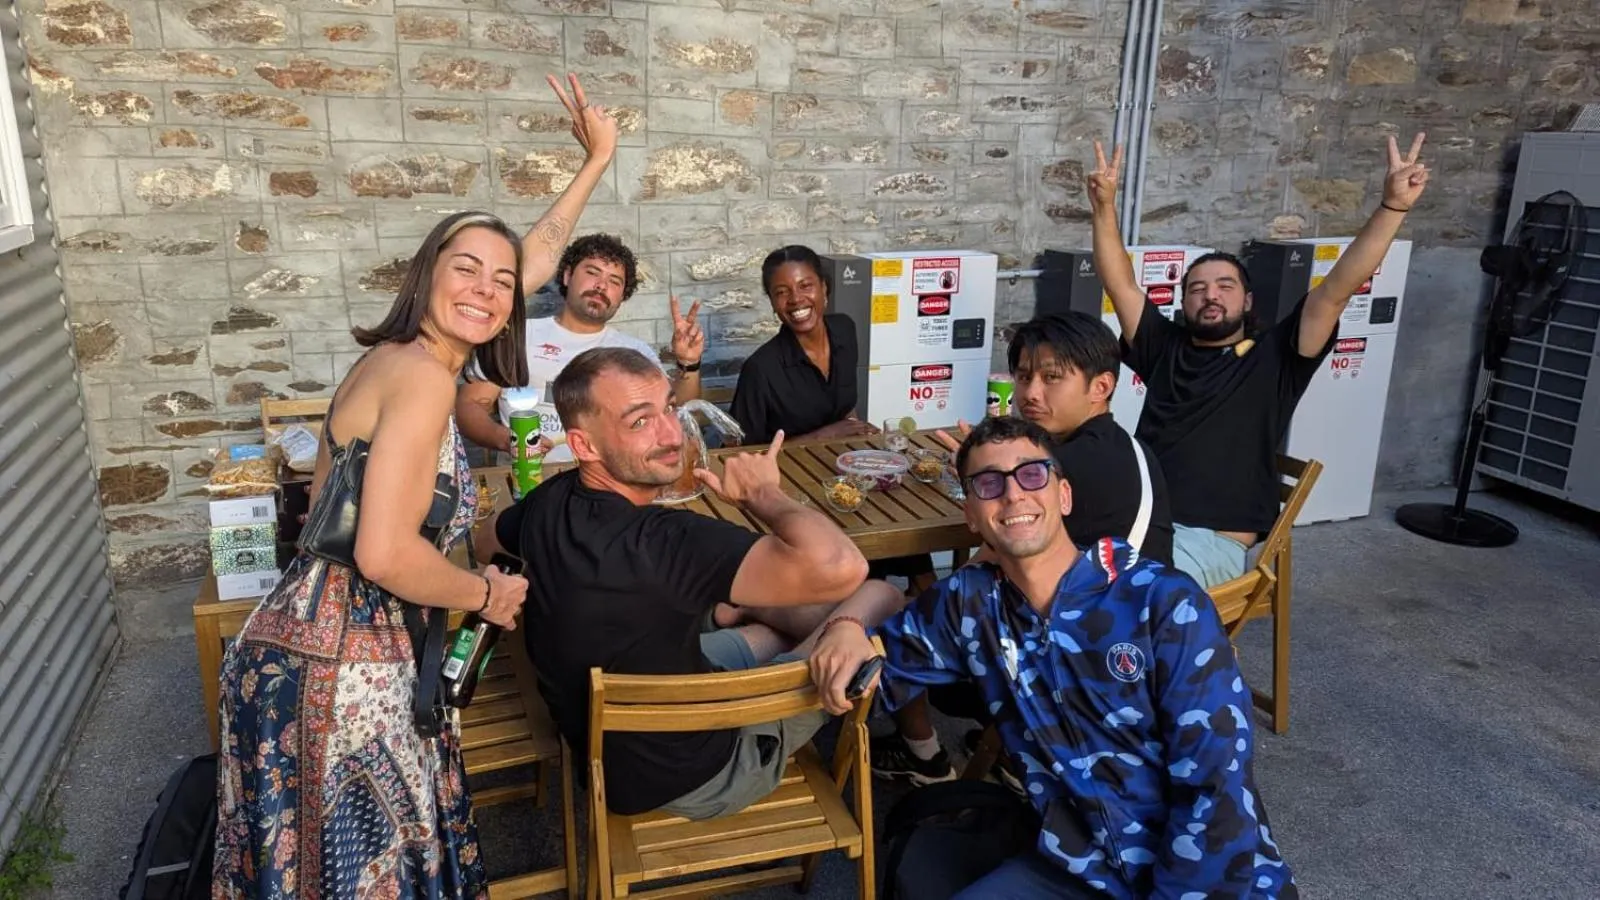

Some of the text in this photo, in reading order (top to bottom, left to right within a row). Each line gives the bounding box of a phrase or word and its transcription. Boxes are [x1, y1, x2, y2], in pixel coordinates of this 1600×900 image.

[914, 259, 959, 268] RESTRICTED ACCESS
[920, 301, 949, 309] DANGER
[1335, 341, 1365, 350] DANGER
[1331, 357, 1349, 370] NO
[914, 368, 950, 378] DANGER
[910, 386, 934, 400] NO
[542, 423, 564, 432] SU
[1110, 644, 1137, 655] PARIS
